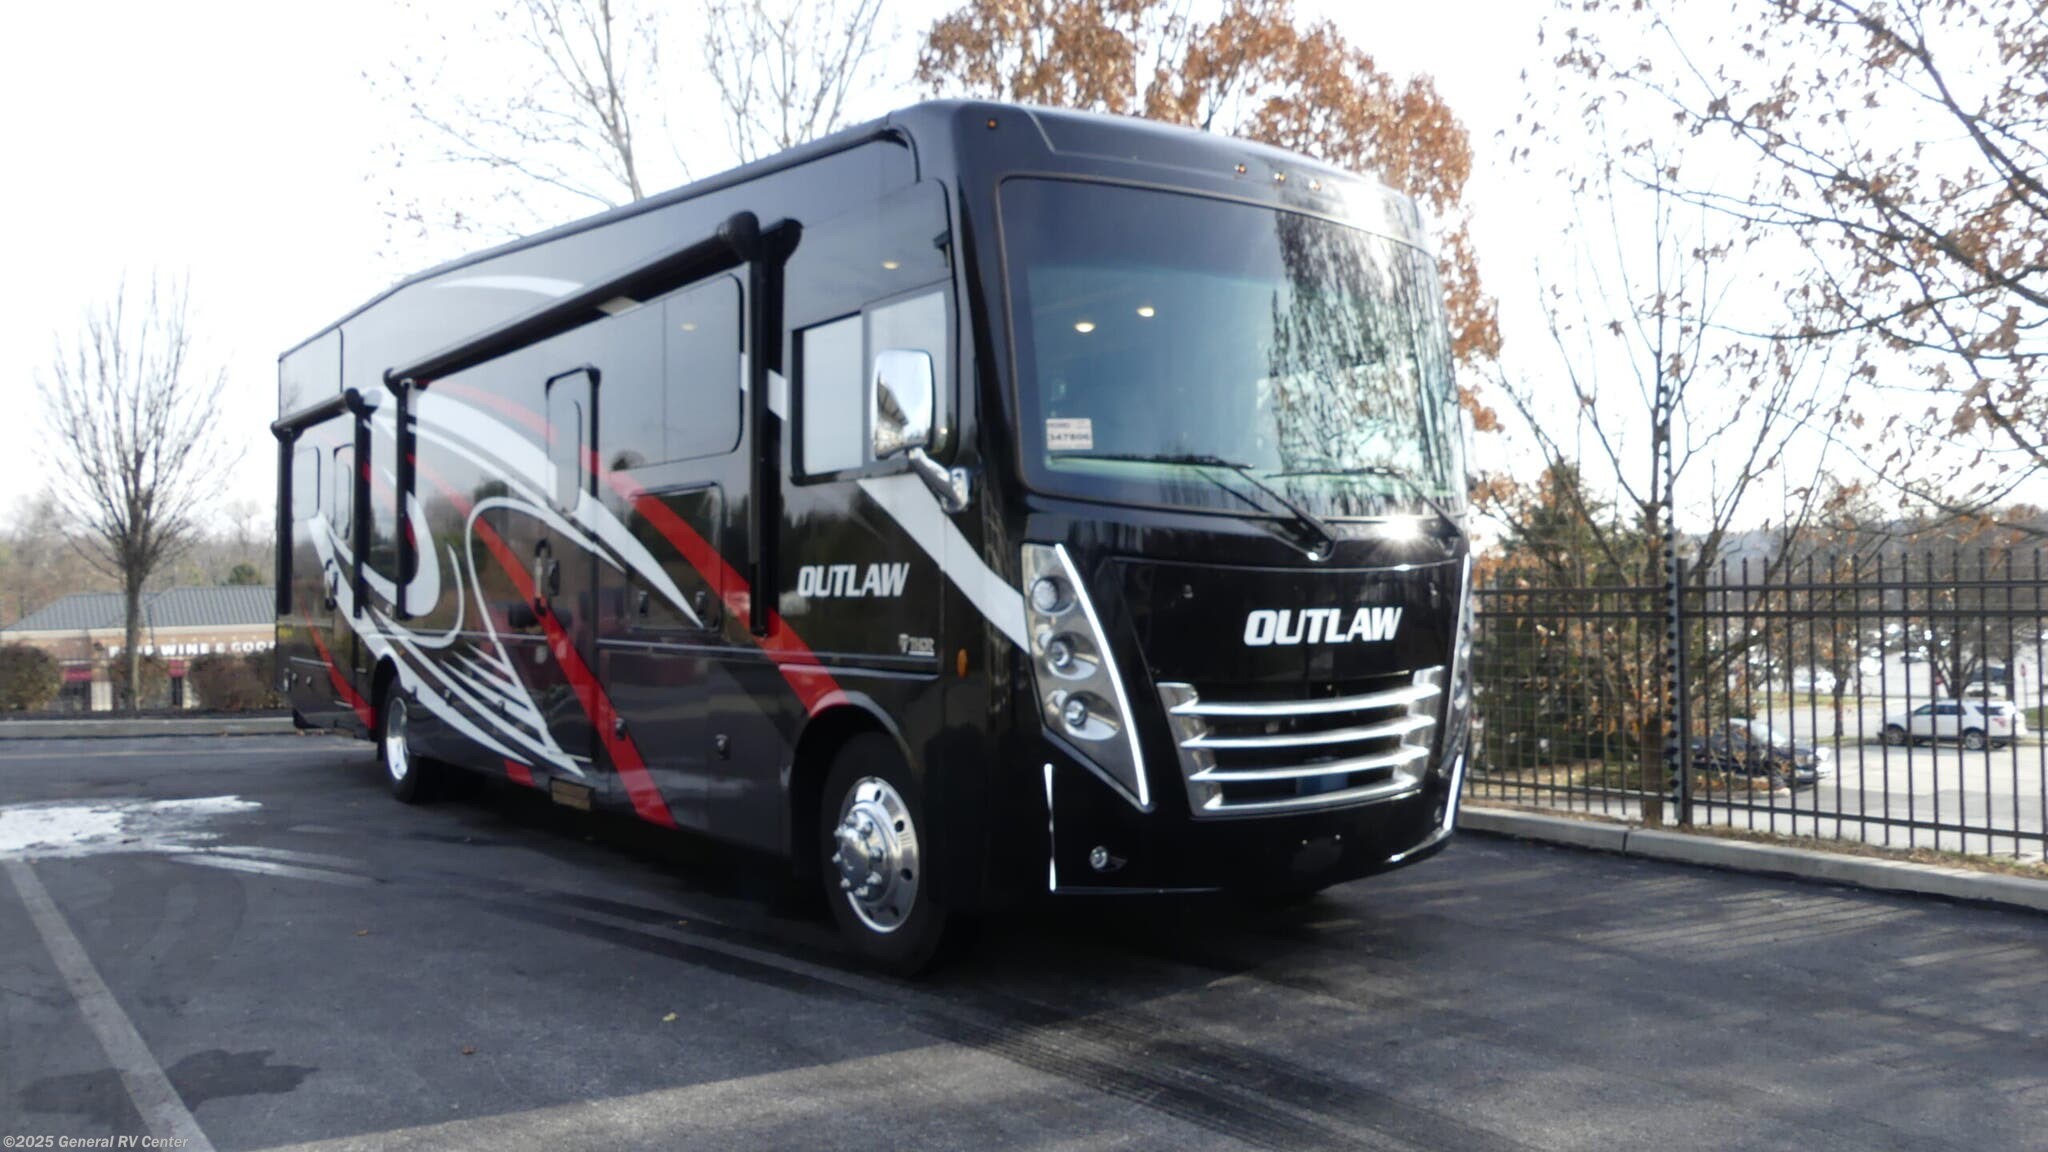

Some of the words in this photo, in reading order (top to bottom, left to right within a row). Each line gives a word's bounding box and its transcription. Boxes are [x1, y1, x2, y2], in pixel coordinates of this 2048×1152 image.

[797, 562, 911, 597] OUTLAW
[1243, 606, 1403, 646] OUTLAW
[160, 642, 210, 656] WINE
